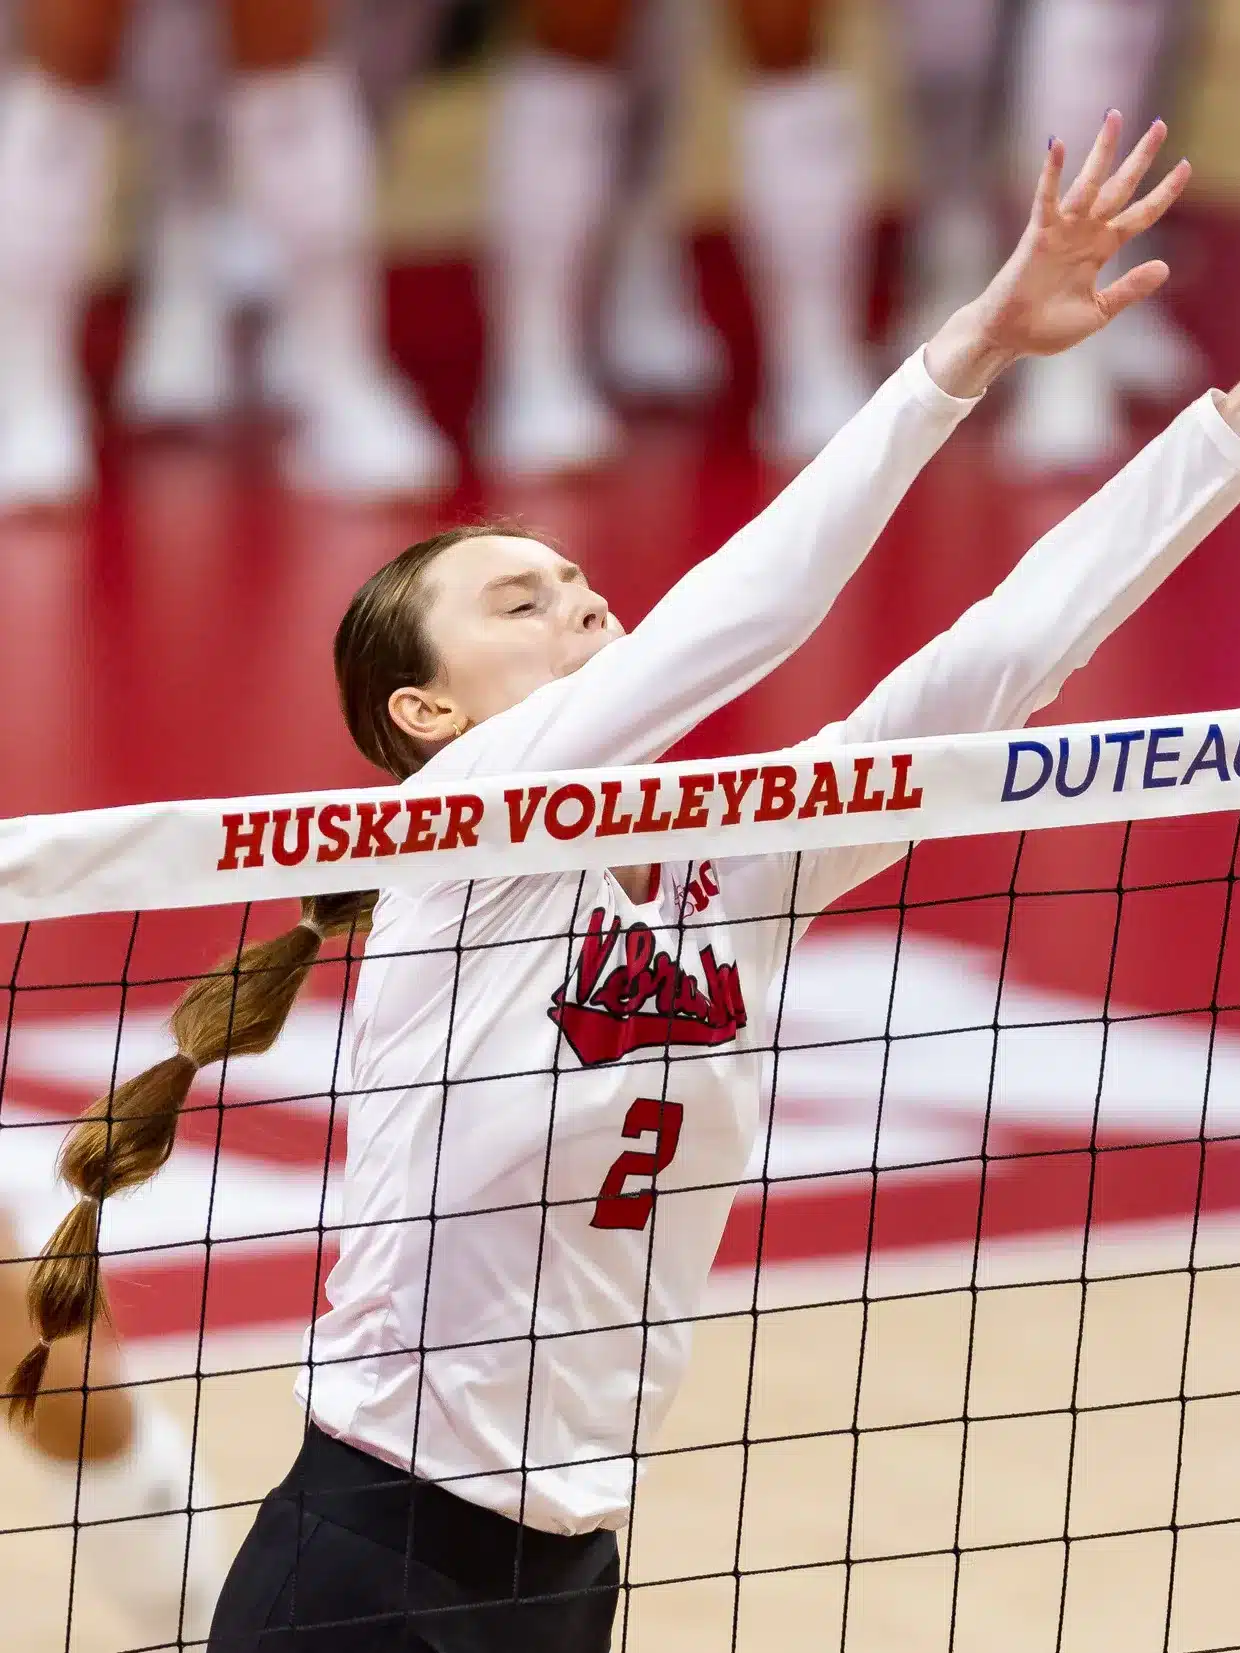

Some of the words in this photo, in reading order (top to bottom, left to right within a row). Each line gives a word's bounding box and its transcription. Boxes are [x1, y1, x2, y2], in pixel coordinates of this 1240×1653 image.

[217, 793, 486, 871] HUSKER
[503, 753, 923, 844] VOLLEYBALL
[589, 1097, 684, 1232] 2
